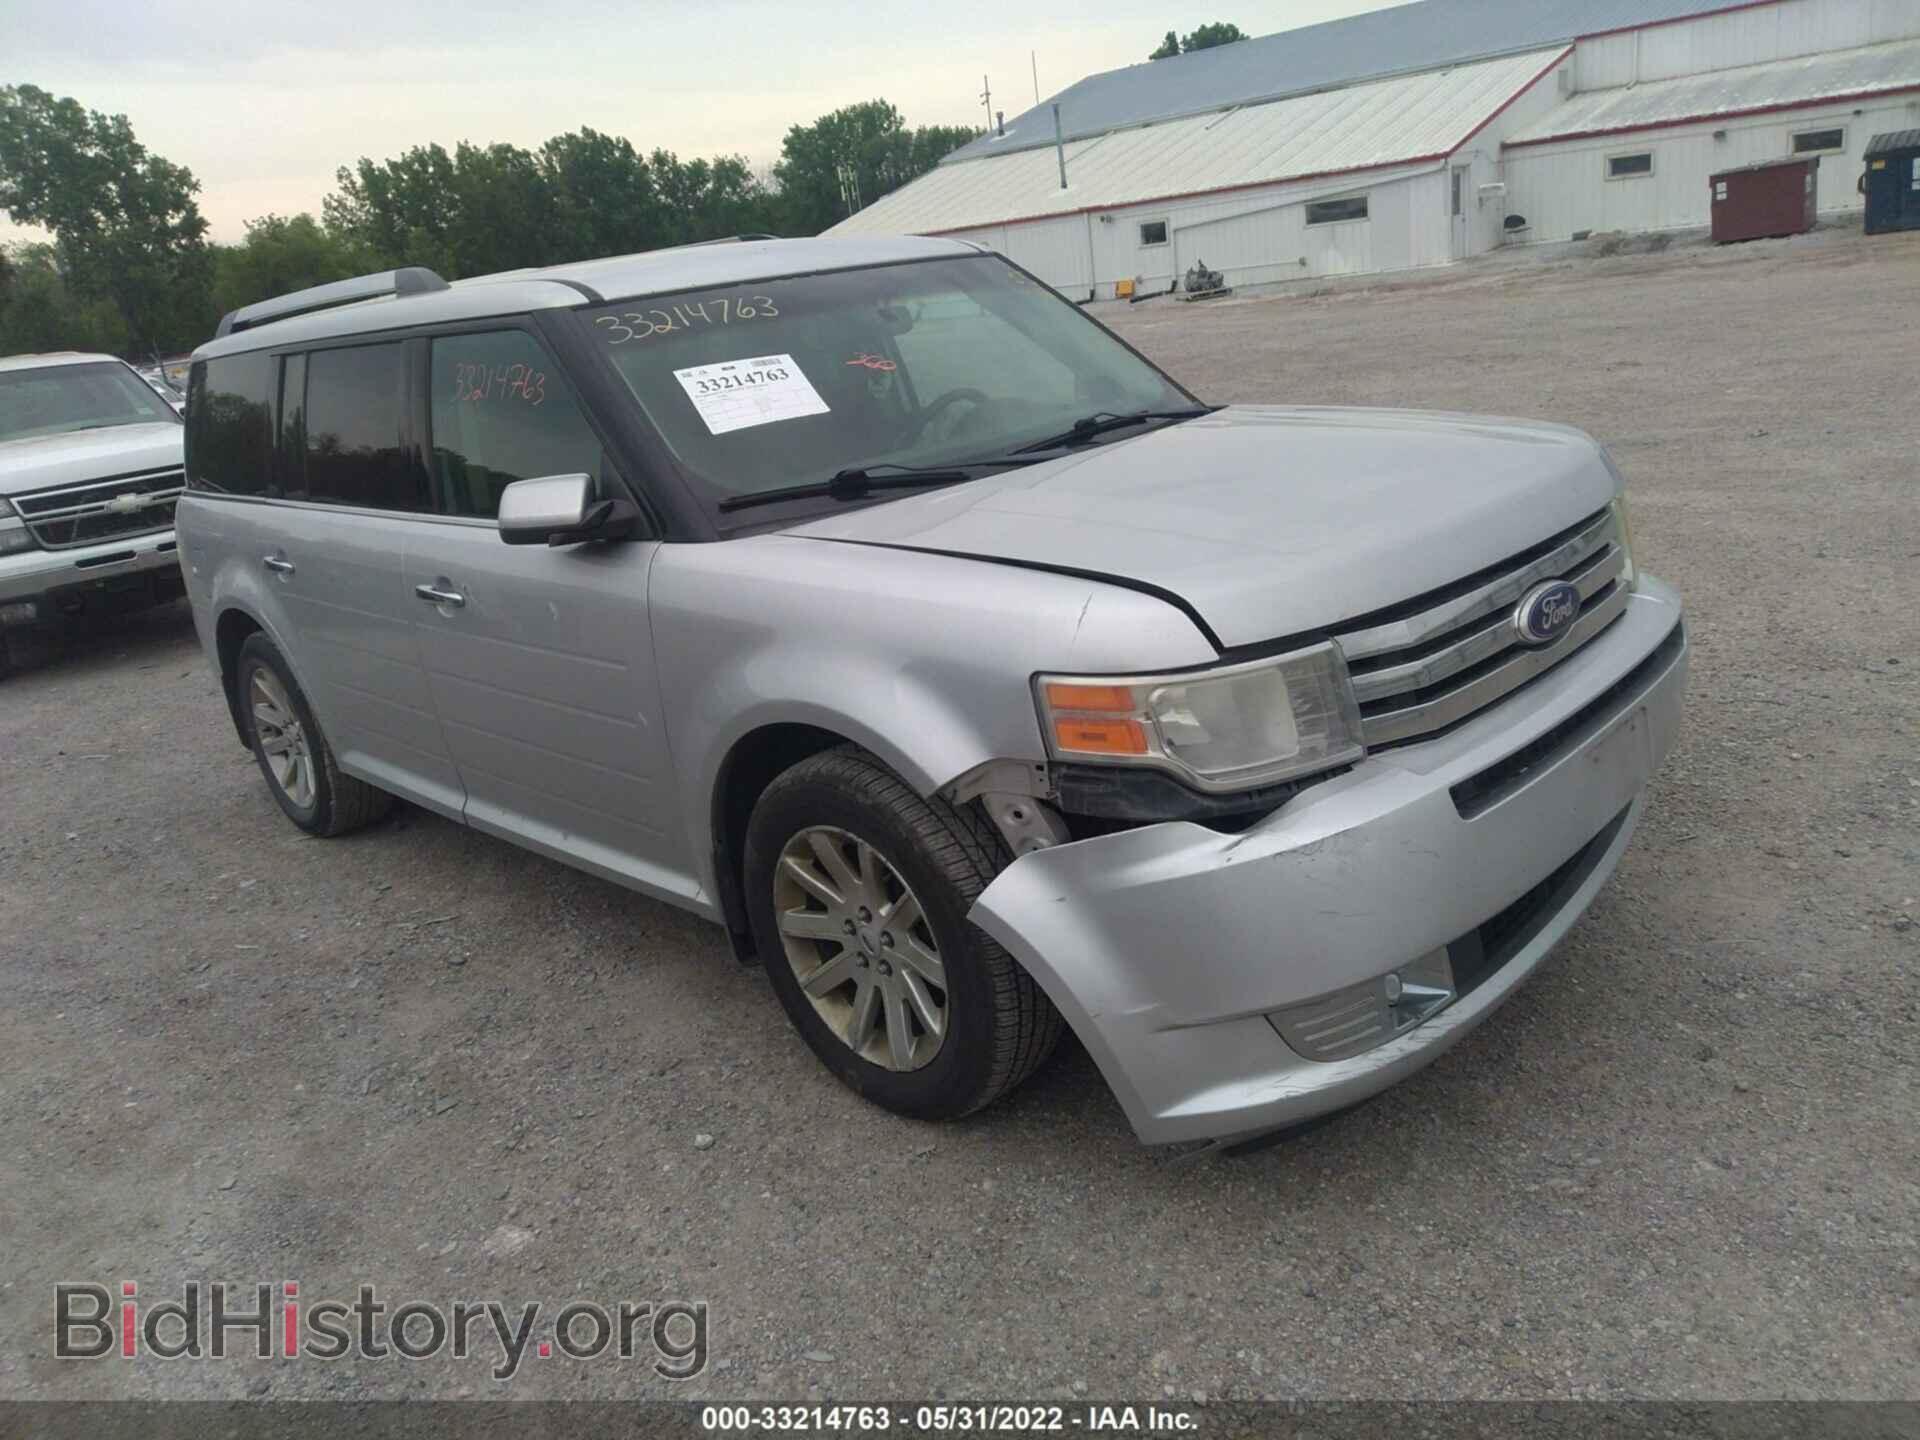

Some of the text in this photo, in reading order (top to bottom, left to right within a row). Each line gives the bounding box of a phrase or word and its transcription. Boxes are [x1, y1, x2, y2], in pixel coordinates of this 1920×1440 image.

[596, 296, 779, 343] 33214763
[454, 361, 545, 406] 33214763
[696, 368, 789, 393] 33214763
[1541, 591, 1573, 630] Ford
